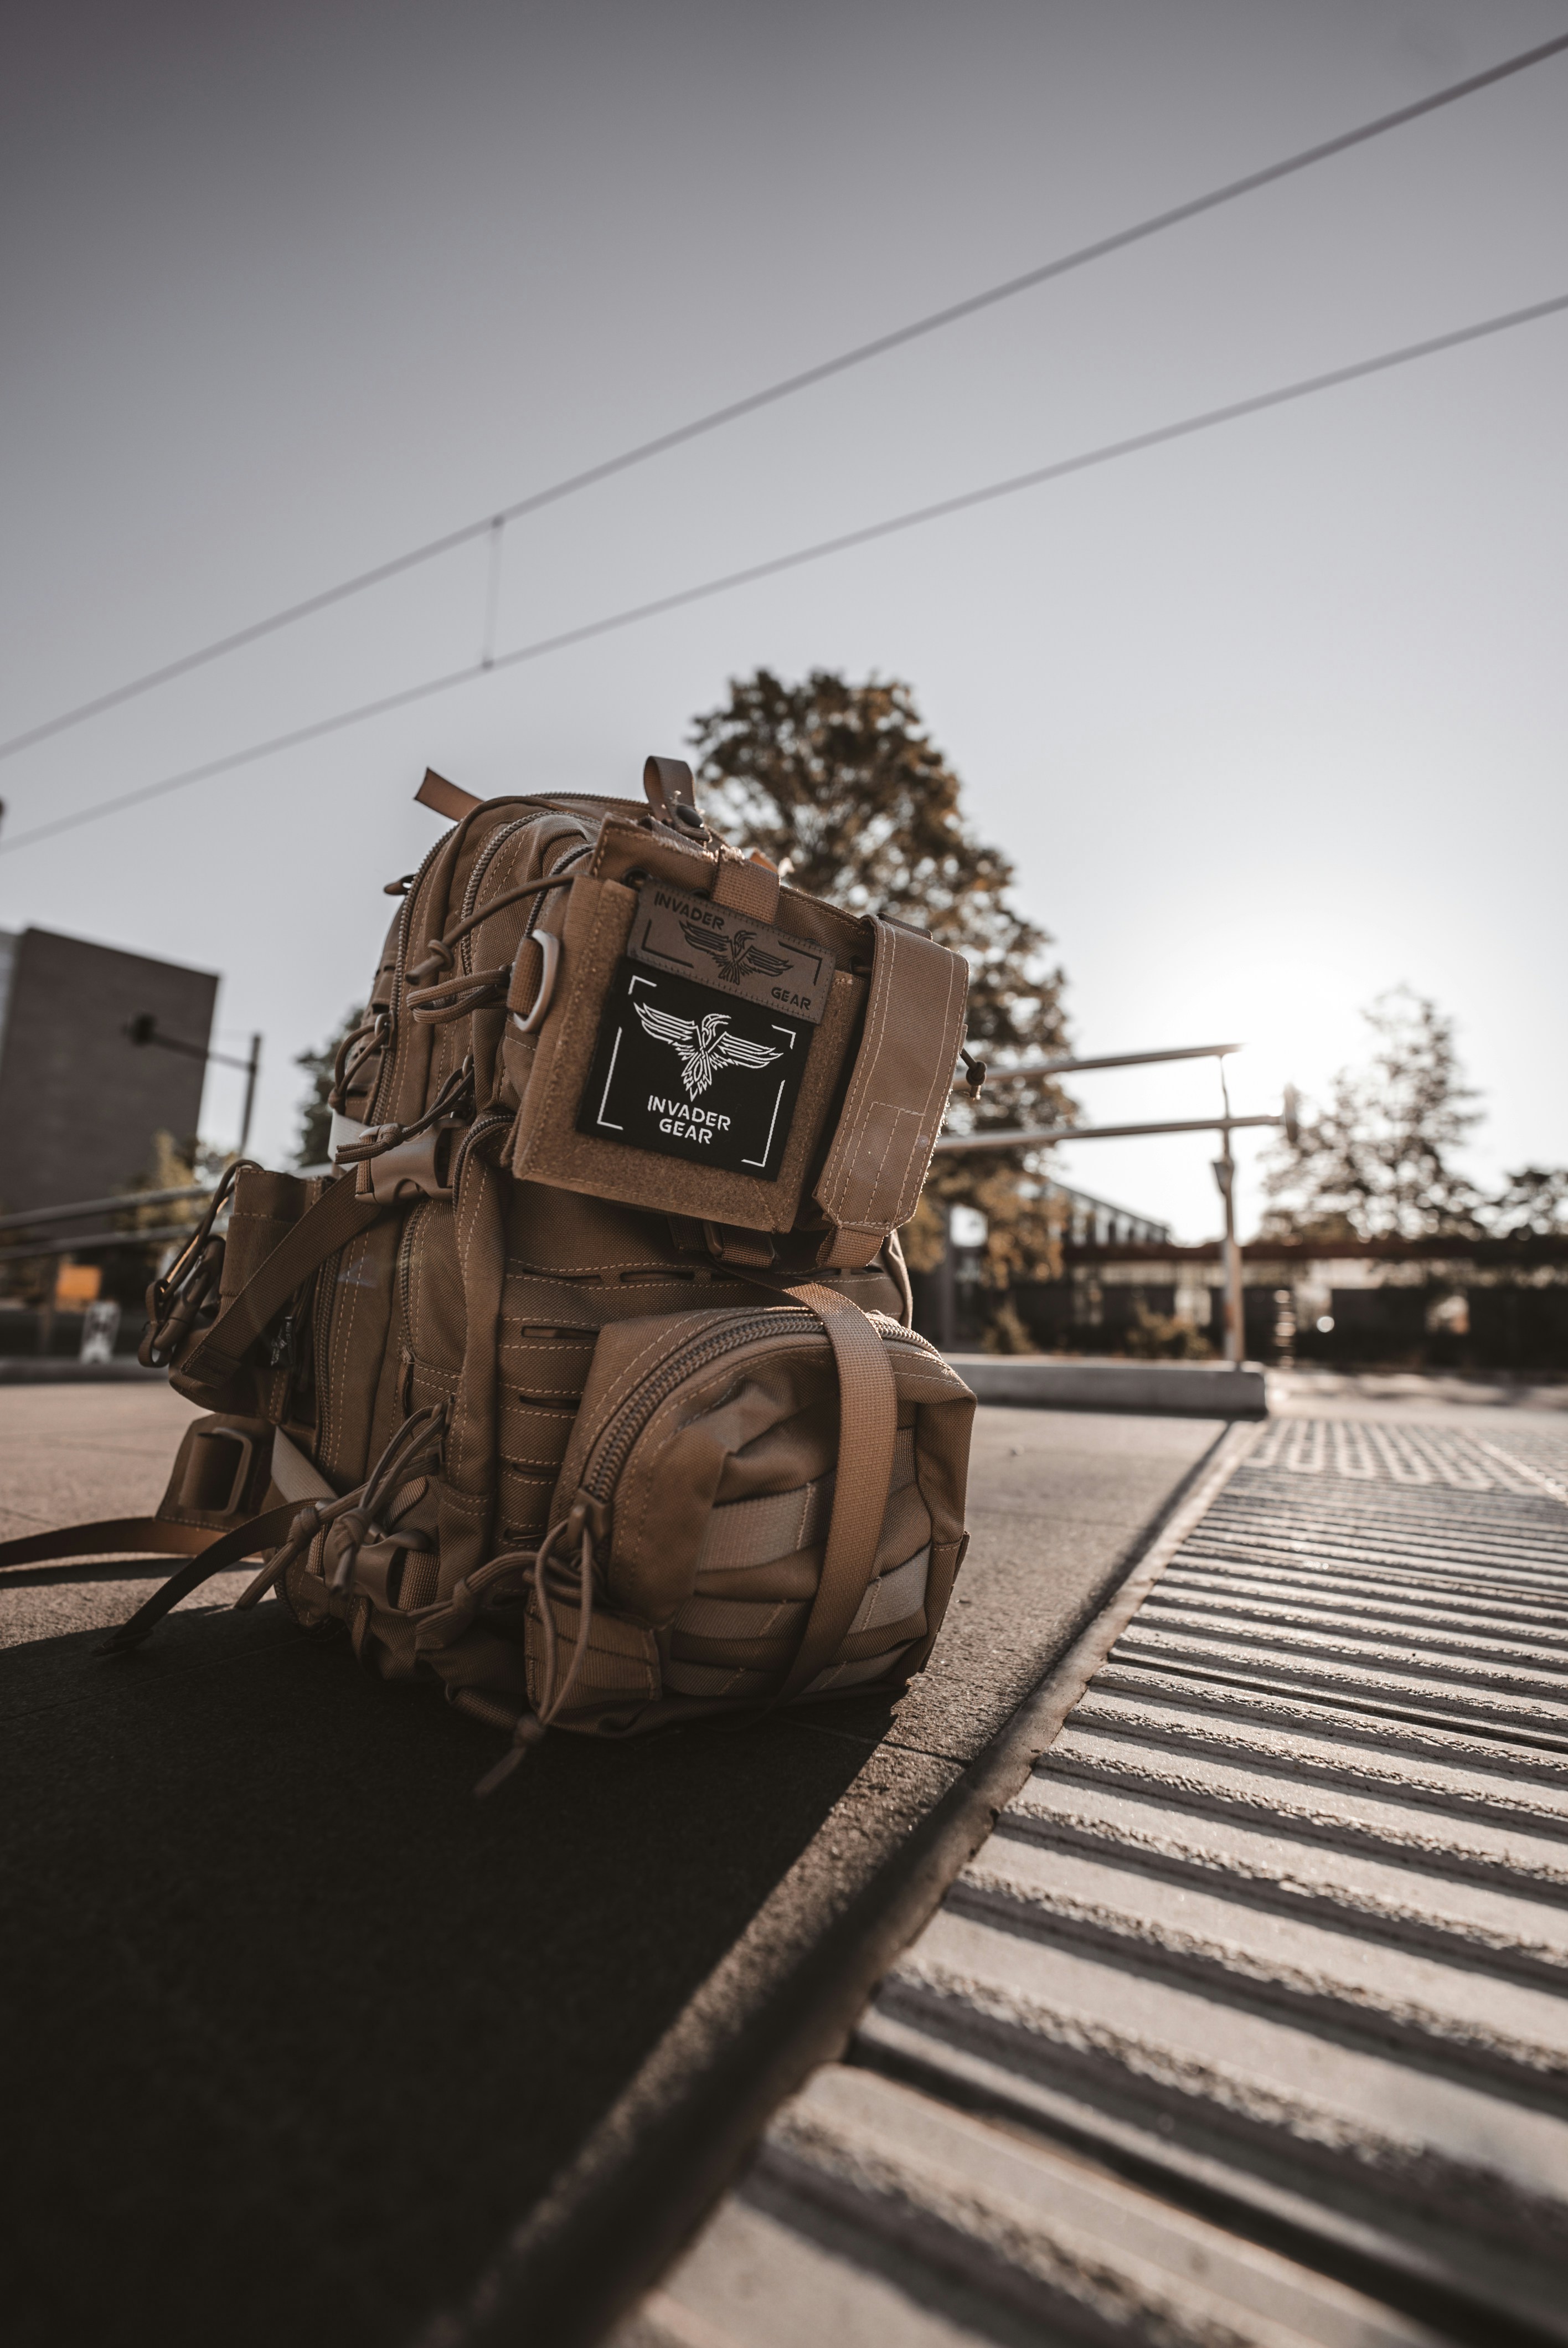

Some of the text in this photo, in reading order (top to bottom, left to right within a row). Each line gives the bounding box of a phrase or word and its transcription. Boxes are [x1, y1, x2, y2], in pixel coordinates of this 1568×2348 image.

[654, 890, 725, 930] INVADER
[771, 987, 812, 1011] GEAR
[647, 1095, 731, 1131] INVADER
[659, 1118, 713, 1144] GEAR
